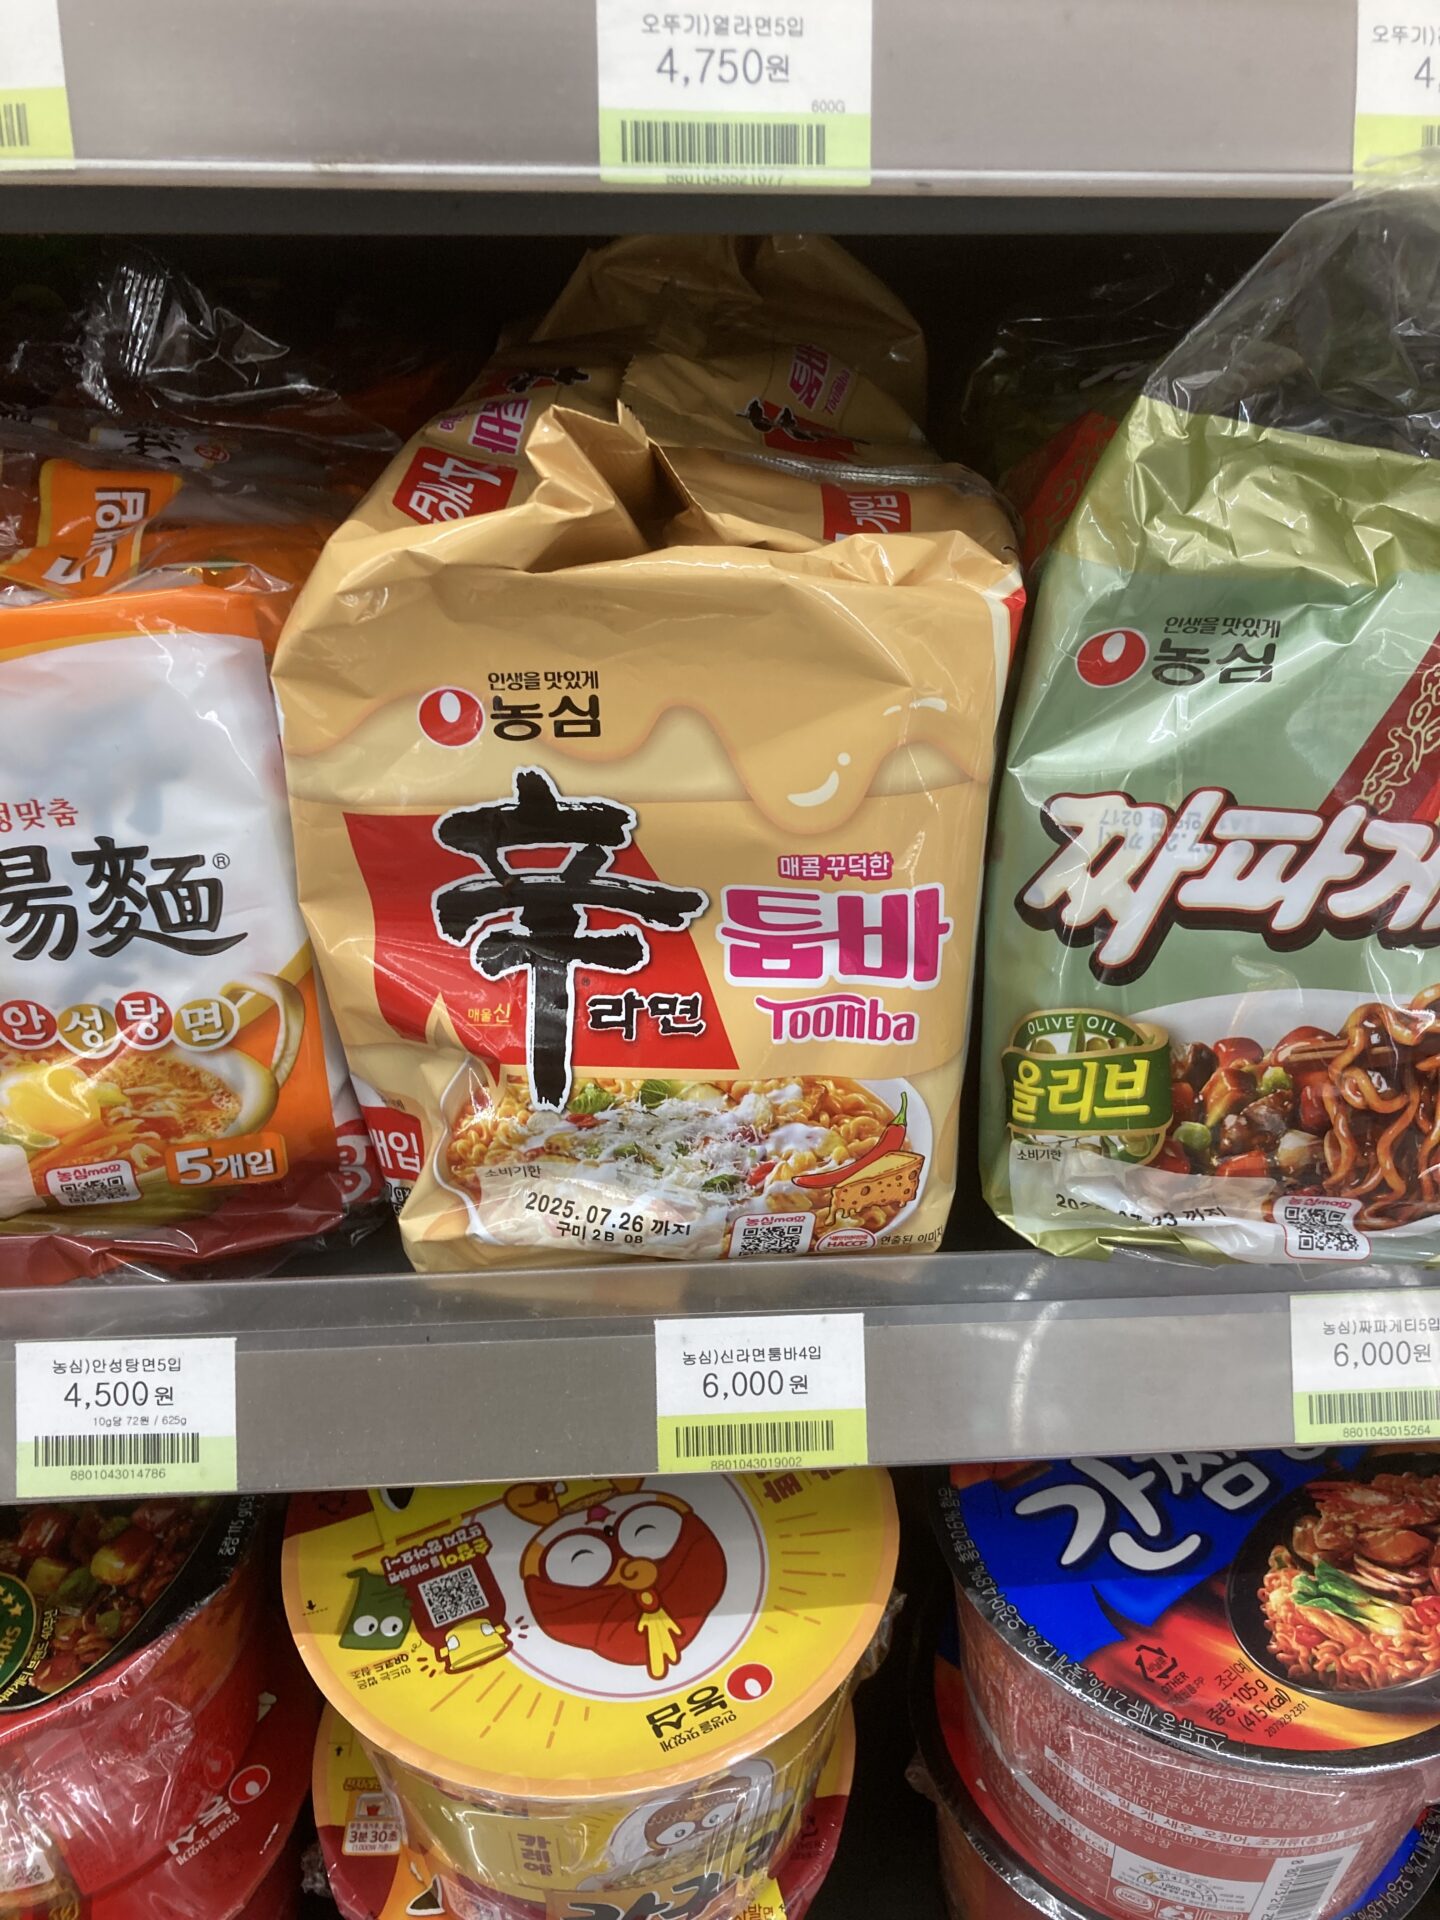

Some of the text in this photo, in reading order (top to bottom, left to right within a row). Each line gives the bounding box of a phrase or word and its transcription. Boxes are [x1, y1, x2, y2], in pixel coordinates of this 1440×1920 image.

[641, 13, 804, 37] 오뚜기)열라면5입
[811, 99, 846, 114] 600G
[833, 494, 901, 543] 개입
[1163, 616, 1281, 639] 인생을 맛있게
[1152, 637, 1277, 686] 농심
[488, 671, 599, 692] 인생을 맛있게
[490, 694, 601, 741] 농심
[779, 853, 890, 878] 매콤 꾸덕한
[432, 766, 709, 1113] 辛
[720, 886, 951, 984] 툼바
[586, 989, 706, 1041] 라면
[754, 994, 916, 1041] Toomba
[1026, 1015, 1118, 1037] OLIVE OIL
[1011, 1059, 1150, 1125] 올리브
[174, 1147, 275, 1185] 5개입
[1016, 1148, 1063, 1162] 소비기한
[484, 1164, 542, 1179] 소비기한
[525, 1190, 691, 1237] 2025.07.26 까지
[556, 1220, 588, 1241] 구미
[624, 1233, 644, 1245] 08
[1322, 1317, 1440, 1336] 농심)짜파게티5입
[52, 1357, 181, 1374] 농심)안성탕면5입
[682, 1346, 821, 1366] 농심)신라면툼바4입
[1334, 1340, 1432, 1369] 6,000원
[93, 1416, 122, 1428] 10g당
[126, 1416, 151, 1426] 72원
[162, 1415, 187, 1426] 625g
[1343, 1425, 1431, 1438] 8801043015264
[70, 1467, 166, 1481] 8801043014786
[711, 1456, 803, 1471] 8801043019002
[0, 1625, 22, 1669] ARS
[1160, 1671, 1190, 1696] OTHER
[1214, 1657, 1254, 1691] 조리예
[646, 1685, 728, 1739] 농심
[1126, 1700, 1158, 1728] 새우
[1237, 1687, 1292, 1733] (415 kcal)
[660, 1709, 737, 1753] 인생을 맛있게
[1158, 1711, 1177, 1735] 중
[1177, 1718, 1229, 1751] 스프류
[1164, 1817, 1197, 1836] 새우,
